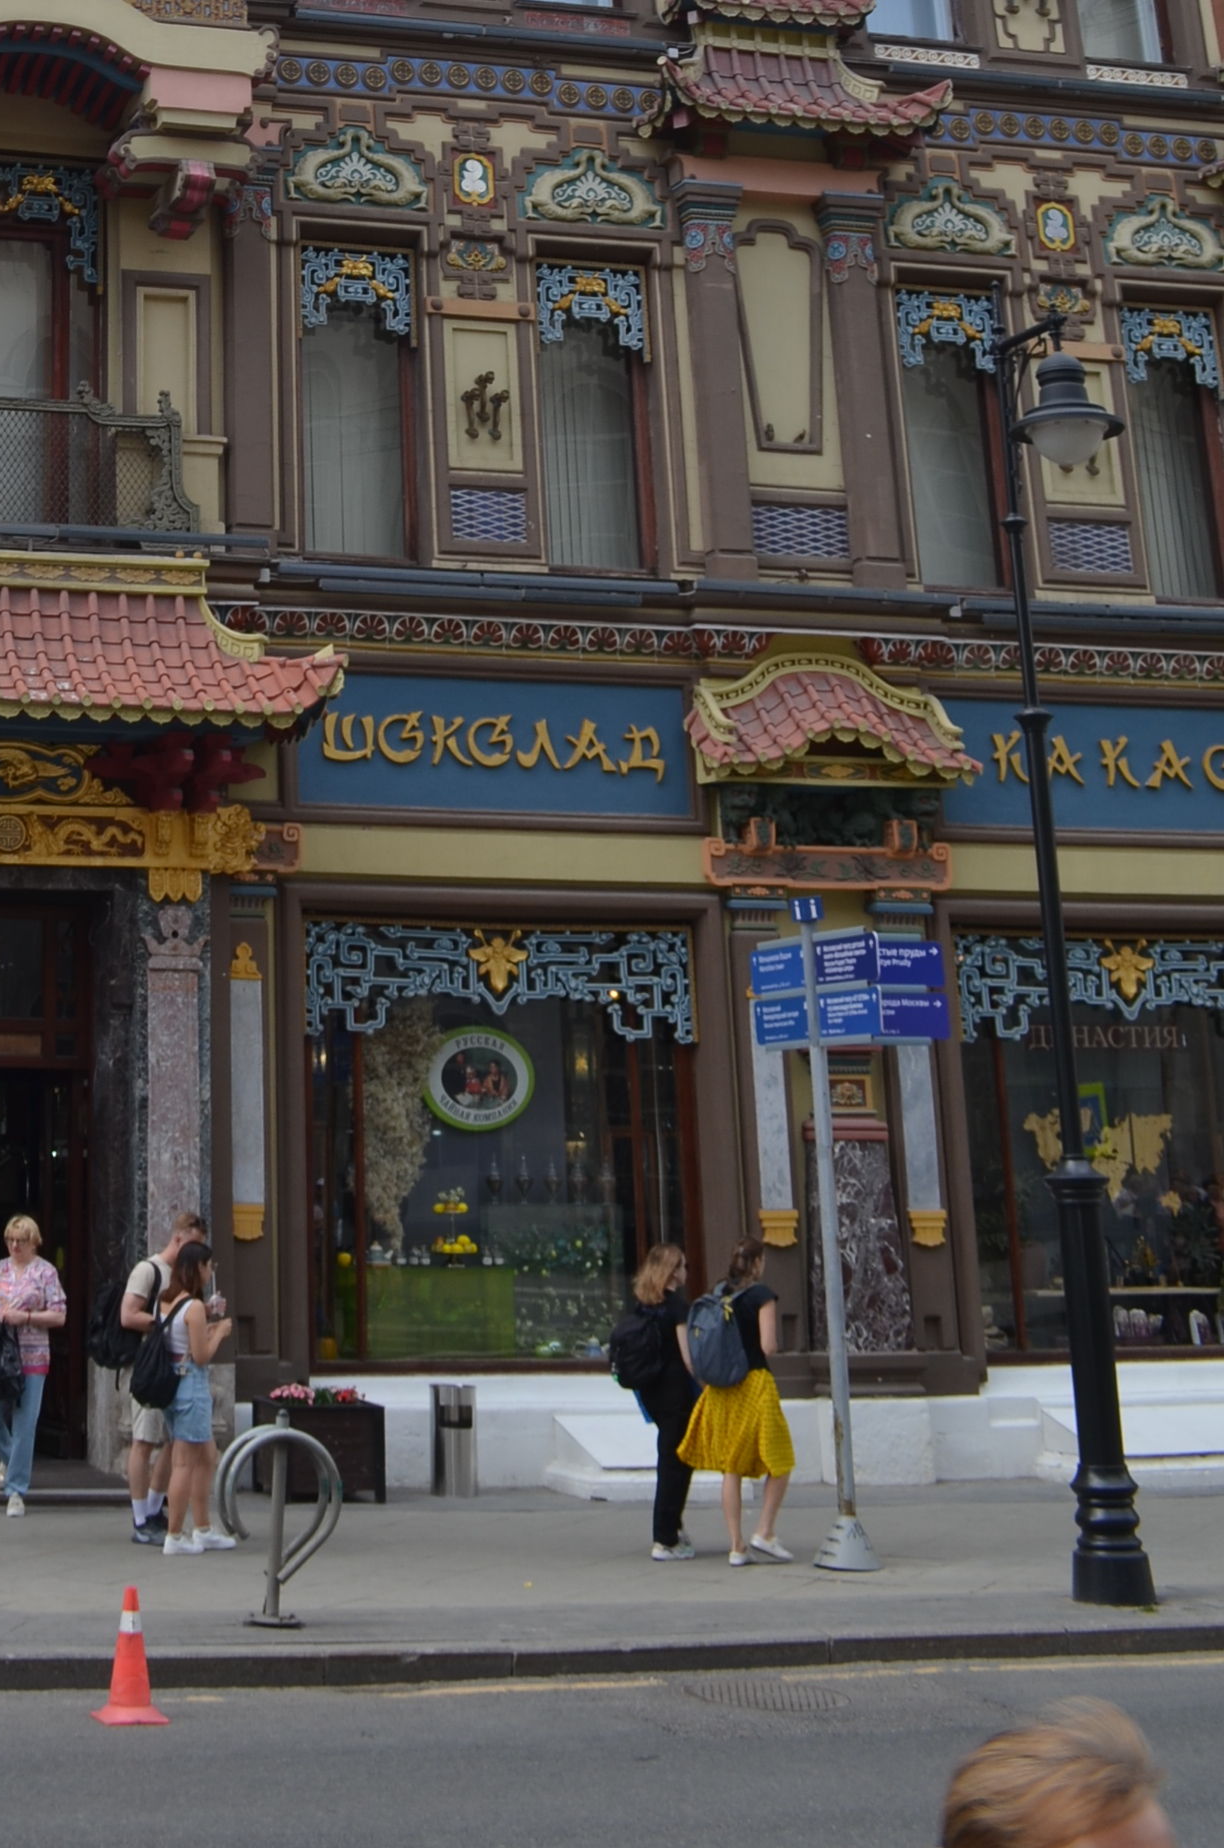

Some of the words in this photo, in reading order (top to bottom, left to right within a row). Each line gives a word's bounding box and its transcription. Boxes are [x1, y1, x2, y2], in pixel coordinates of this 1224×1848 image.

[322, 711, 665, 784] ШОКОЛАД
[455, 1035, 505, 1051] РУССКАЯ
[1029, 1024, 1179, 1051] ДНАСТИЯ
